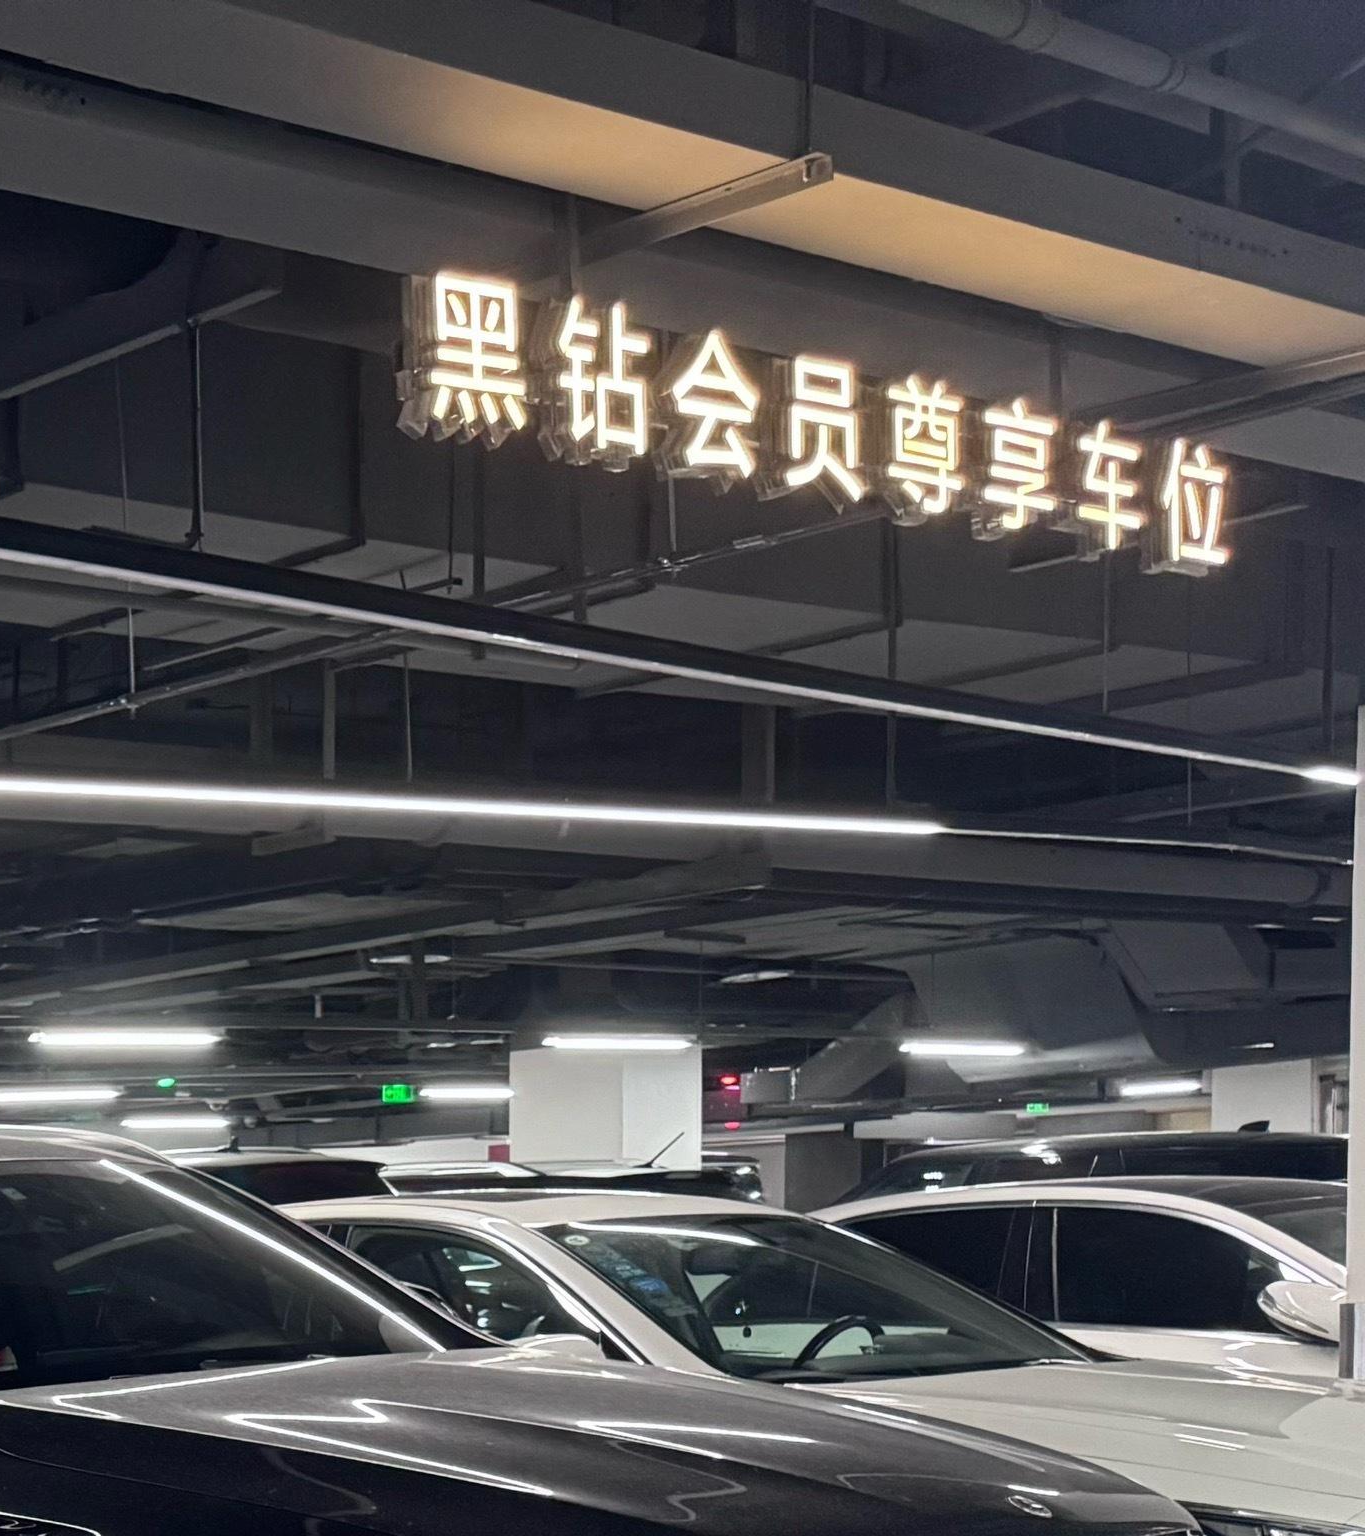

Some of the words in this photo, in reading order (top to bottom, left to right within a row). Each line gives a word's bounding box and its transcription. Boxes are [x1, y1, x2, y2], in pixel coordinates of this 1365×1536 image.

[430, 271, 1230, 566] 黑钻会员尊享车位
